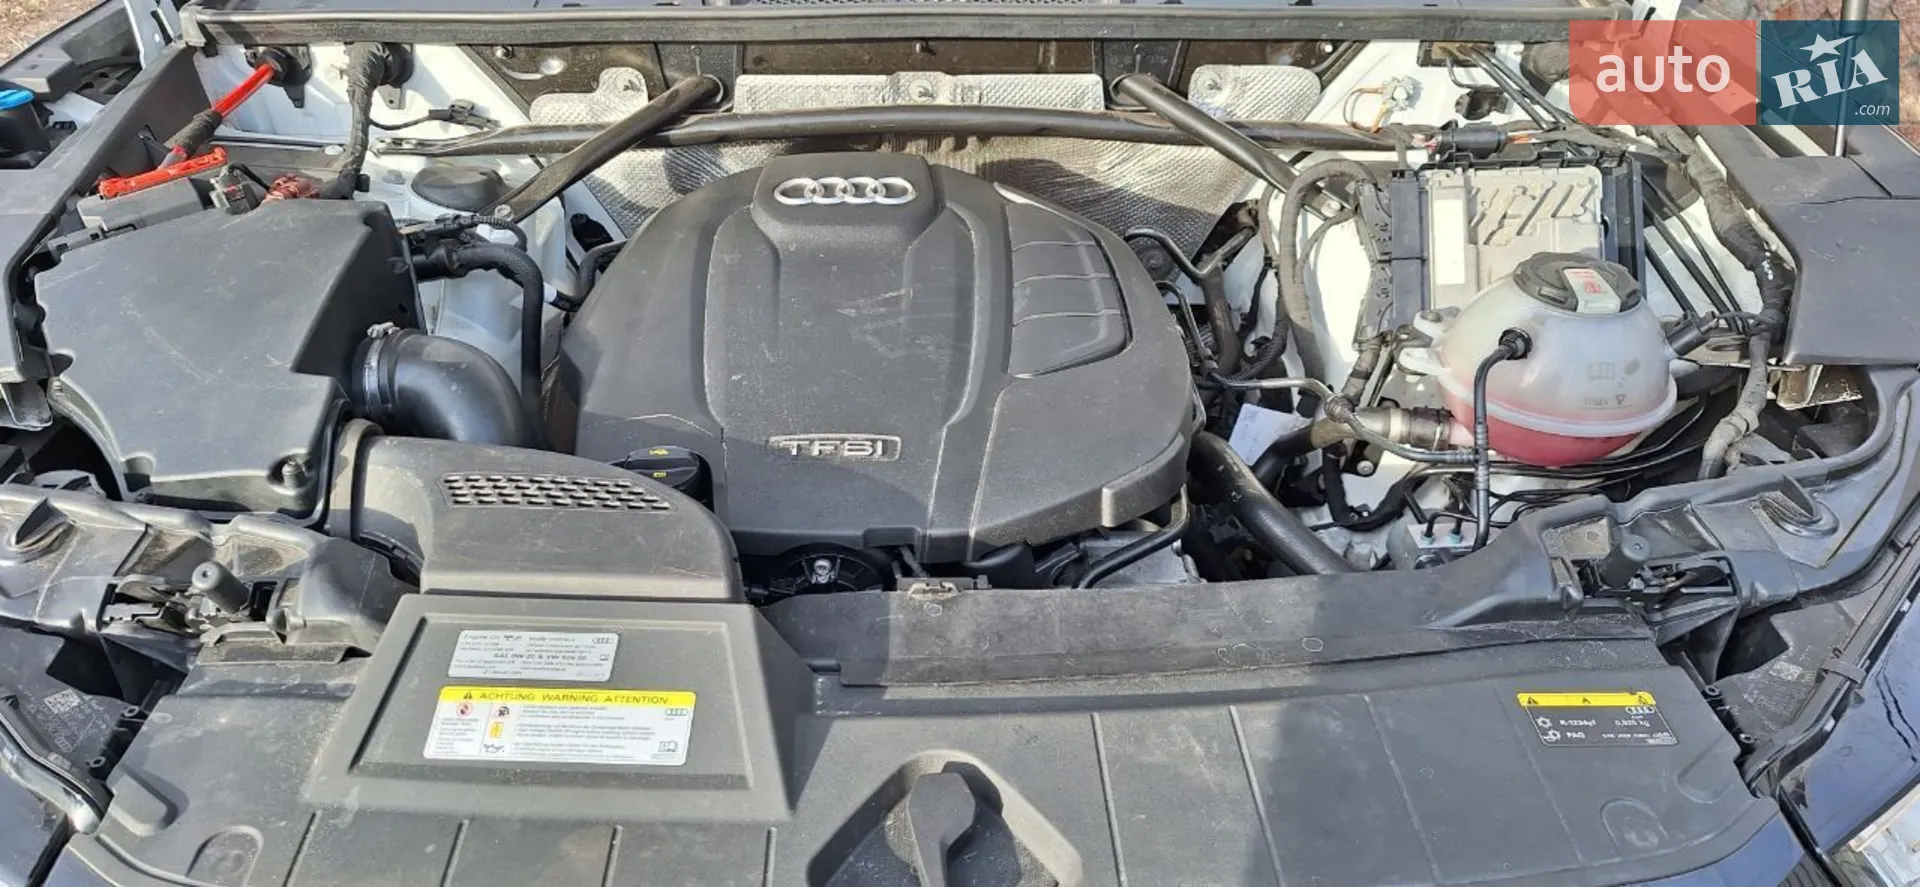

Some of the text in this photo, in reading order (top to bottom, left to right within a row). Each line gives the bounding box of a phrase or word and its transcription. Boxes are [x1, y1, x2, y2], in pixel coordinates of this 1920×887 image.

[1585, 397, 1608, 406] max
[780, 440, 883, 456] TFSI
[479, 692, 669, 704] ACHTUNG WARNING ATTENTION
